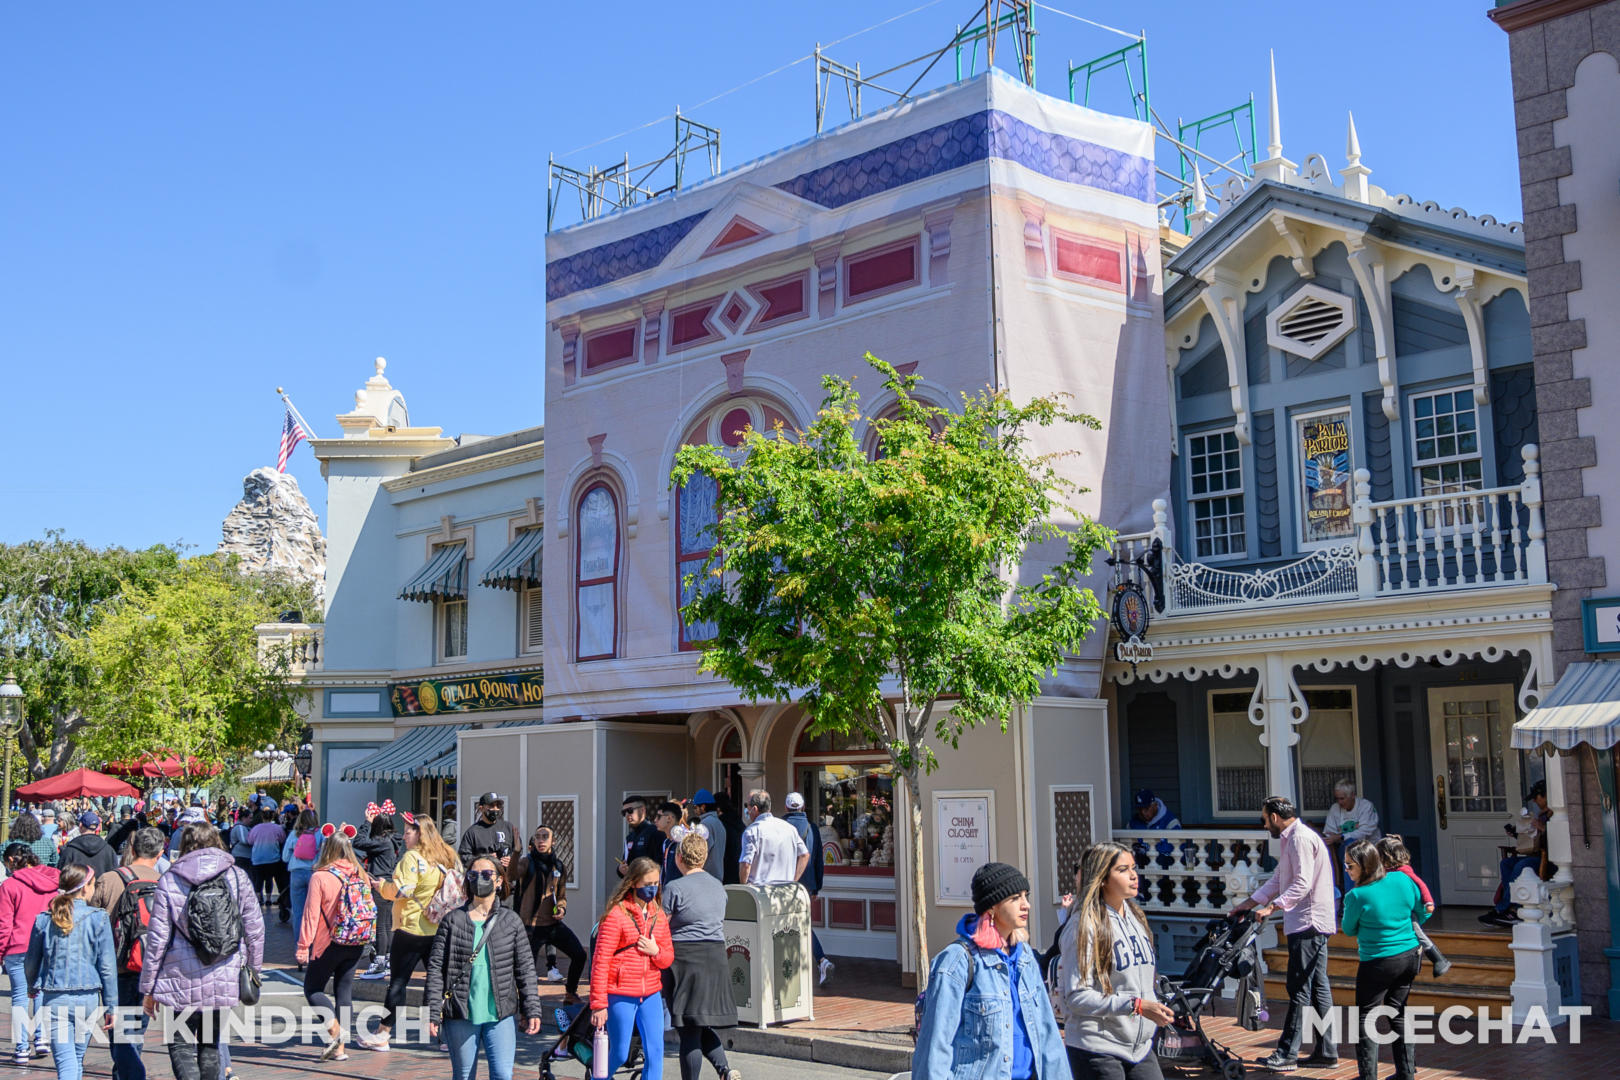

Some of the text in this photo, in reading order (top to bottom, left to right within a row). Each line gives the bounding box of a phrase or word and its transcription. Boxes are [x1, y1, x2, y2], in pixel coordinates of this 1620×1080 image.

[1314, 422, 1347, 440] PALM
[1304, 437, 1348, 460] PARLOR
[441, 682, 478, 704] PLAZA
[479, 679, 519, 699] POINT
[951, 817, 974, 827] CHINA
[947, 829, 978, 838] CLOSET
